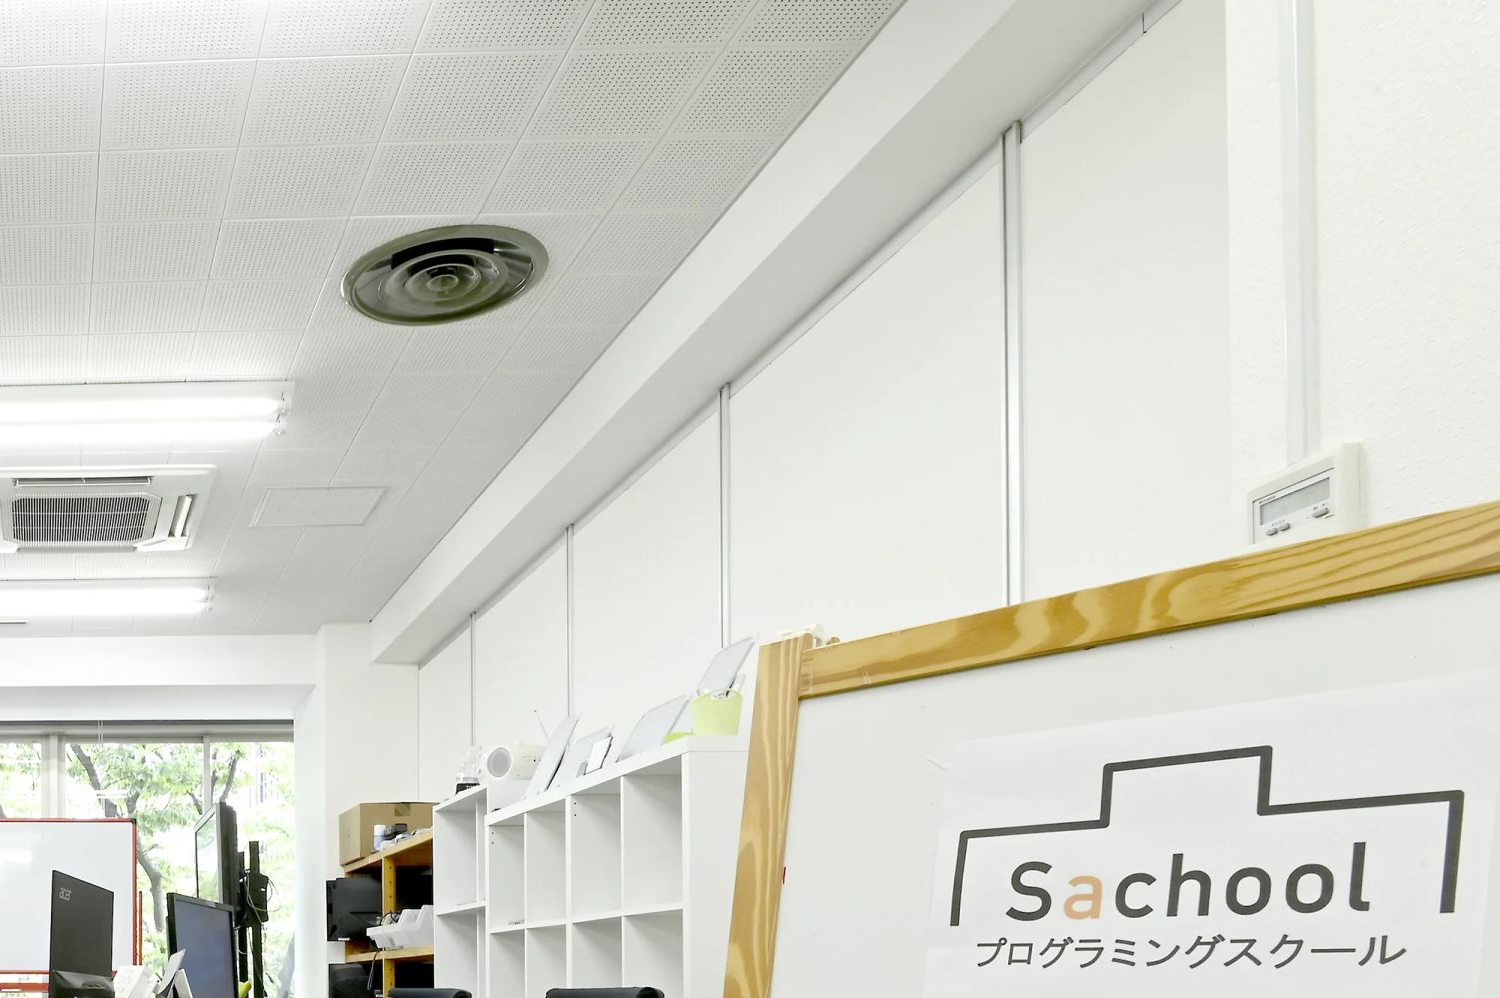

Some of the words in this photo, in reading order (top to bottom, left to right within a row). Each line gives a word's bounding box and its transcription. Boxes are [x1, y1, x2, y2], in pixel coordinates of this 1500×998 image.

[59, 887, 72, 901] acer
[1004, 841, 1371, 922] Sachool
[976, 932, 1408, 970] プログラミングスクール
